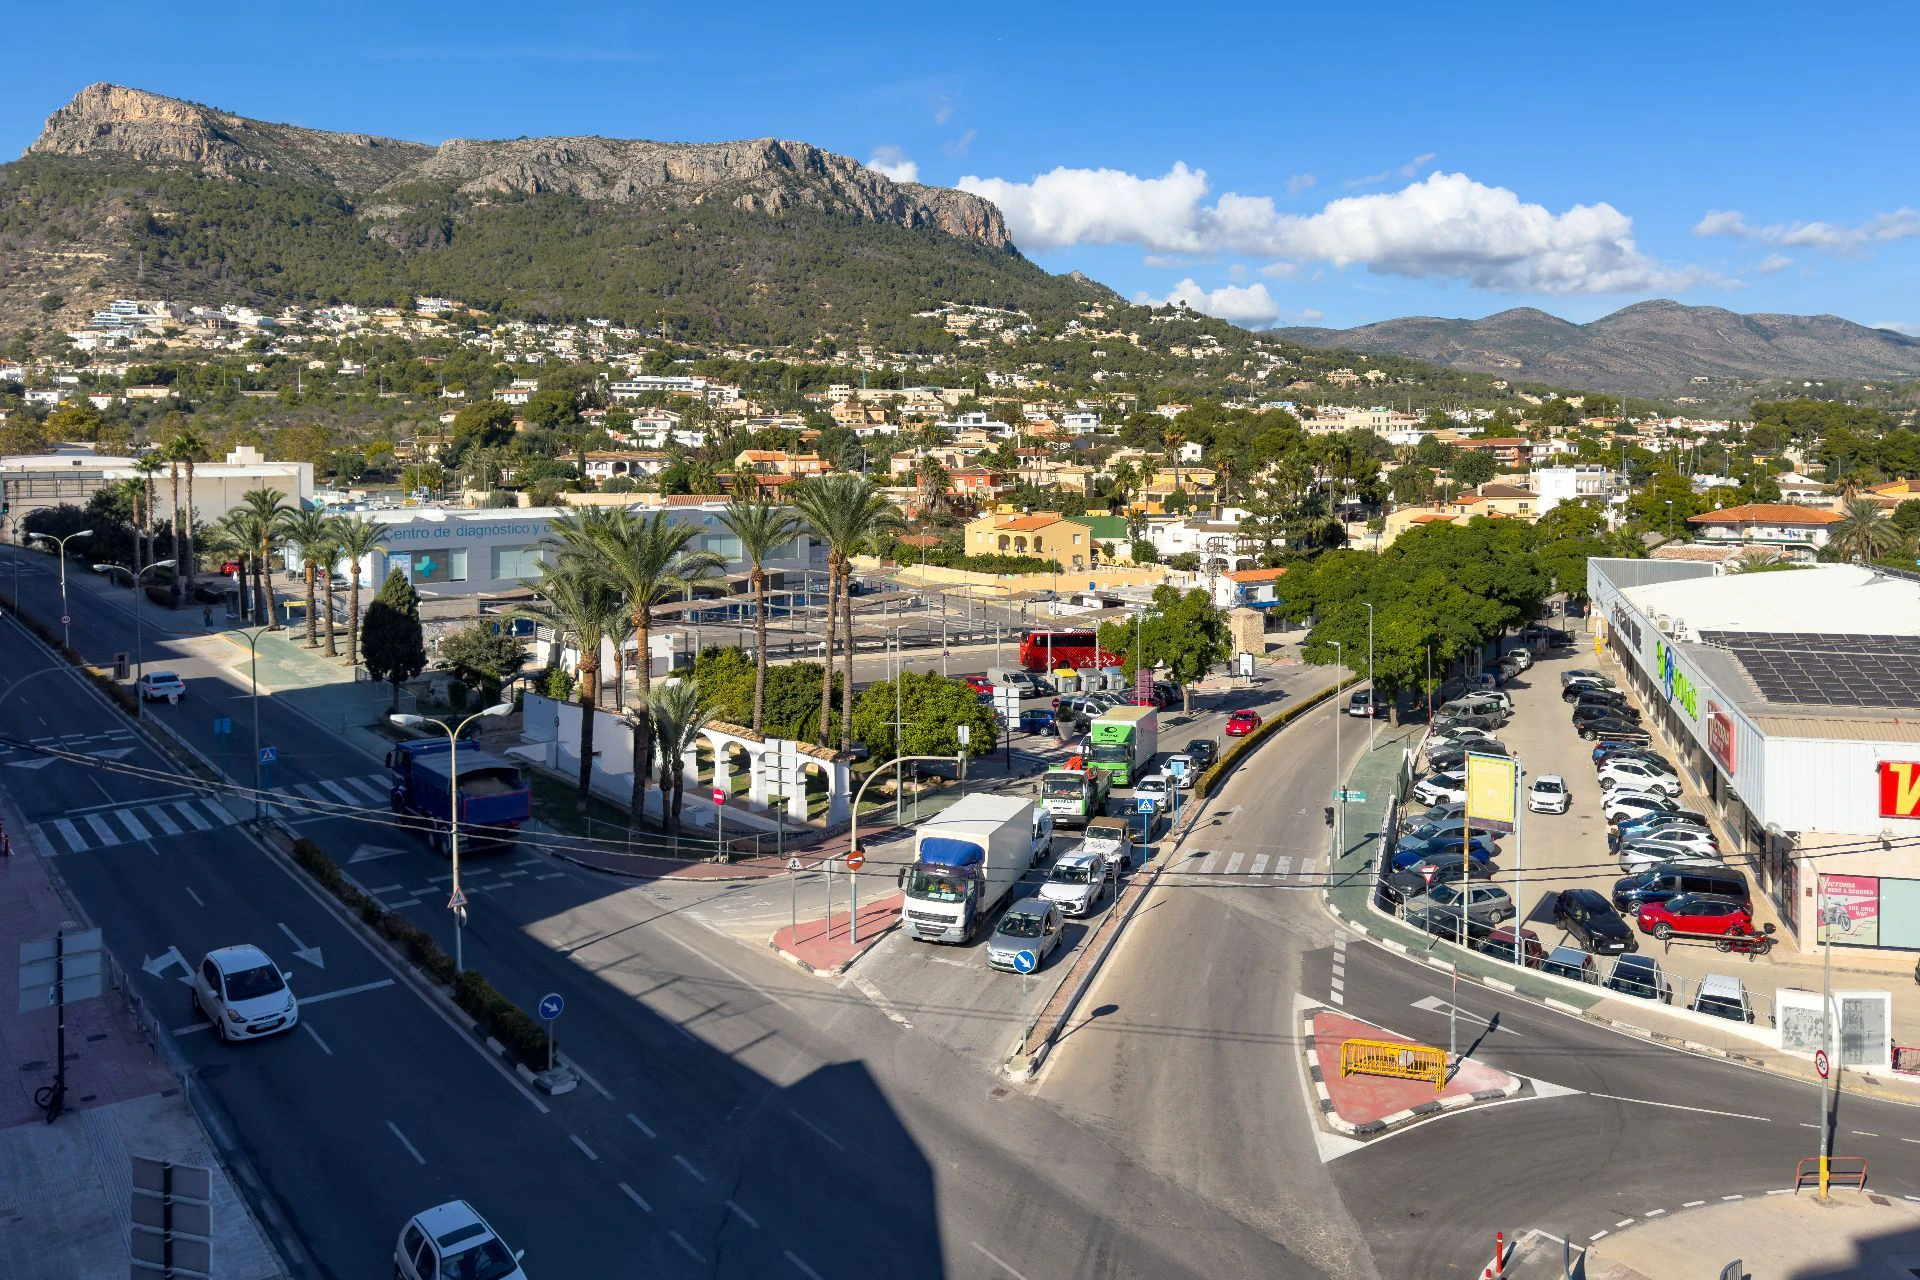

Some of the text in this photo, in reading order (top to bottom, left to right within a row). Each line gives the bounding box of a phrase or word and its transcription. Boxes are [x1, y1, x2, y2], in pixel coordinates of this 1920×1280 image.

[382, 523, 540, 541] Centro de diagnóstico y
[1820, 877, 1856, 889] VICTORIA
